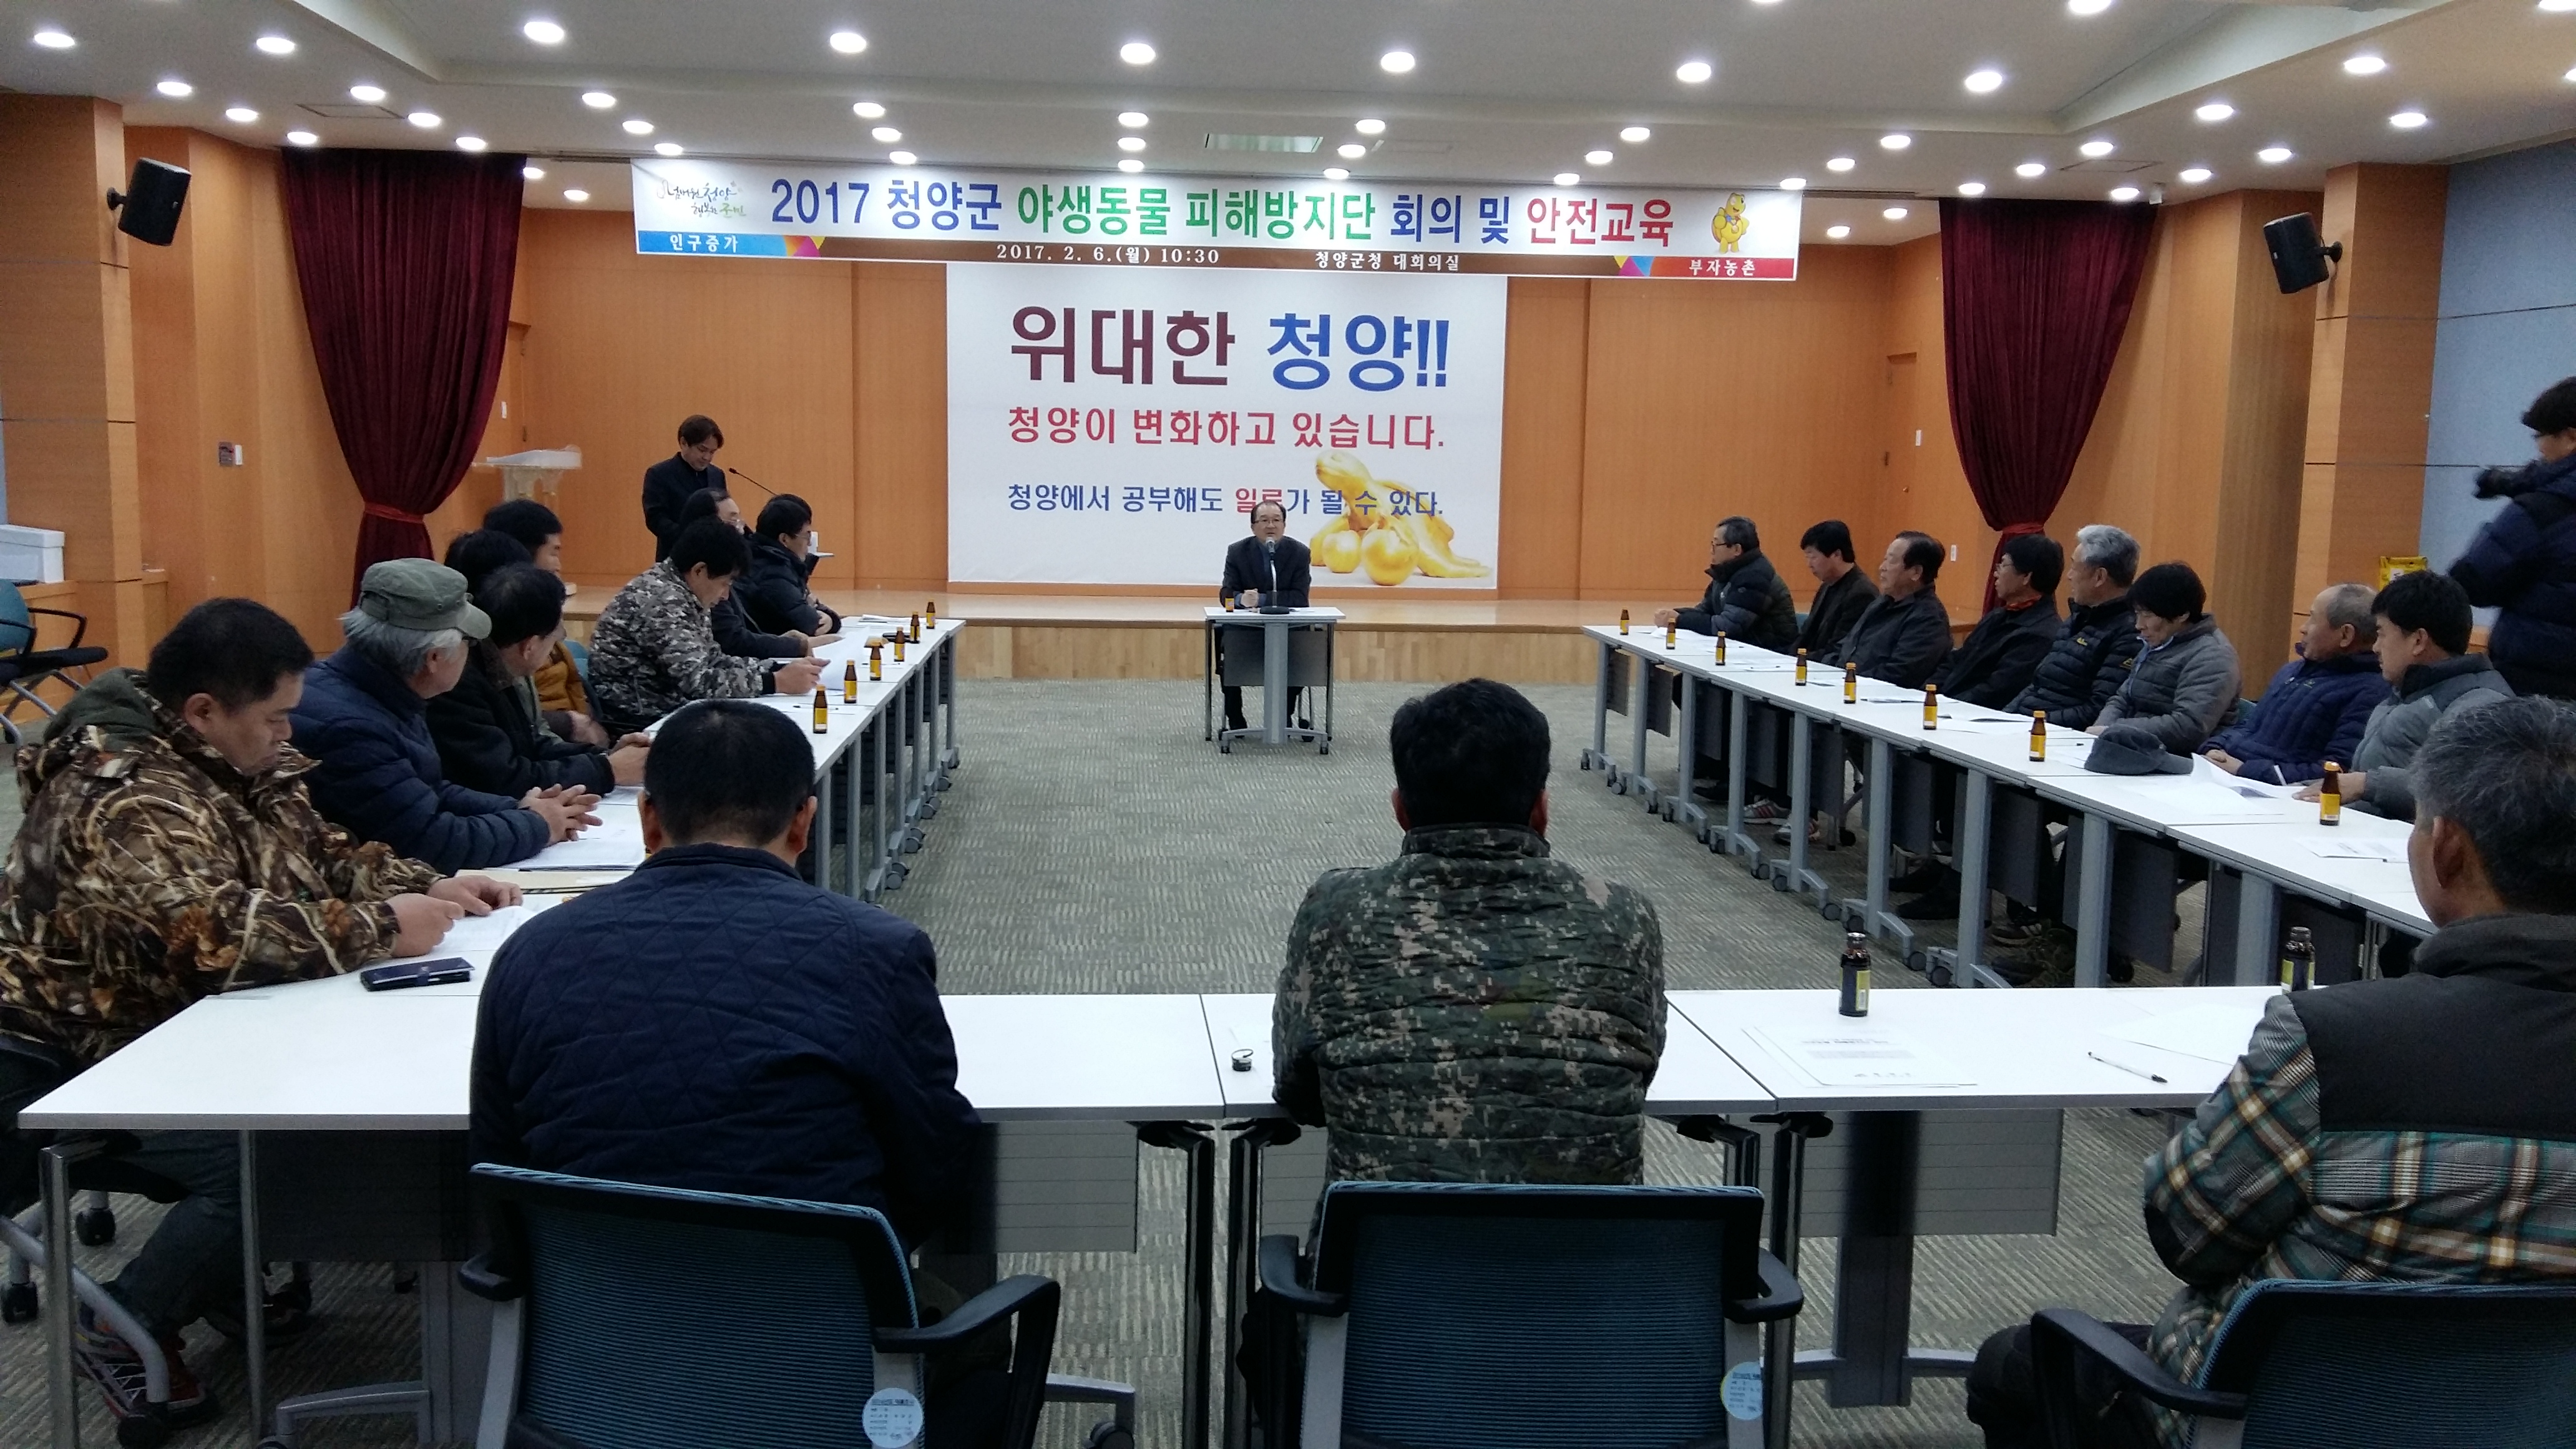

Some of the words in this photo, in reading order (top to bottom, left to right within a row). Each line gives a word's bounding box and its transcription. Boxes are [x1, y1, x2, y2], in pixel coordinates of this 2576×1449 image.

[771, 178, 869, 224] 2017
[887, 180, 1002, 231] 청양군
[1018, 184, 1170, 235] 야생동물
[1186, 188, 1375, 240] 피해방지단
[1390, 193, 1461, 243] 회의
[1479, 196, 1510, 244] 및
[1527, 197, 1674, 248] 안전교육
[670, 234, 738, 253] 인구증가
[997, 244, 1052, 261] 2017.
[1064, 246, 1081, 261] 2.
[1161, 248, 1219, 264] 10:30
[1315, 251, 1380, 270] 청양군청
[1394, 253, 1459, 271] 대회의실
[1689, 259, 1755, 276] 부자농촌
[1011, 306, 1236, 386] 위대한
[1267, 313, 1450, 392] 청양!!
[1008, 406, 1115, 444] 청양이
[1134, 409, 1276, 446] 변화하고
[1292, 412, 1443, 450] 있습니다.
[1008, 484, 1110, 511] 청양에서
[1122, 486, 1223, 513] 공부해도
[1320, 490, 1342, 515] 될
[1355, 490, 1377, 515] 수
[1390, 490, 1443, 517] 있다.
